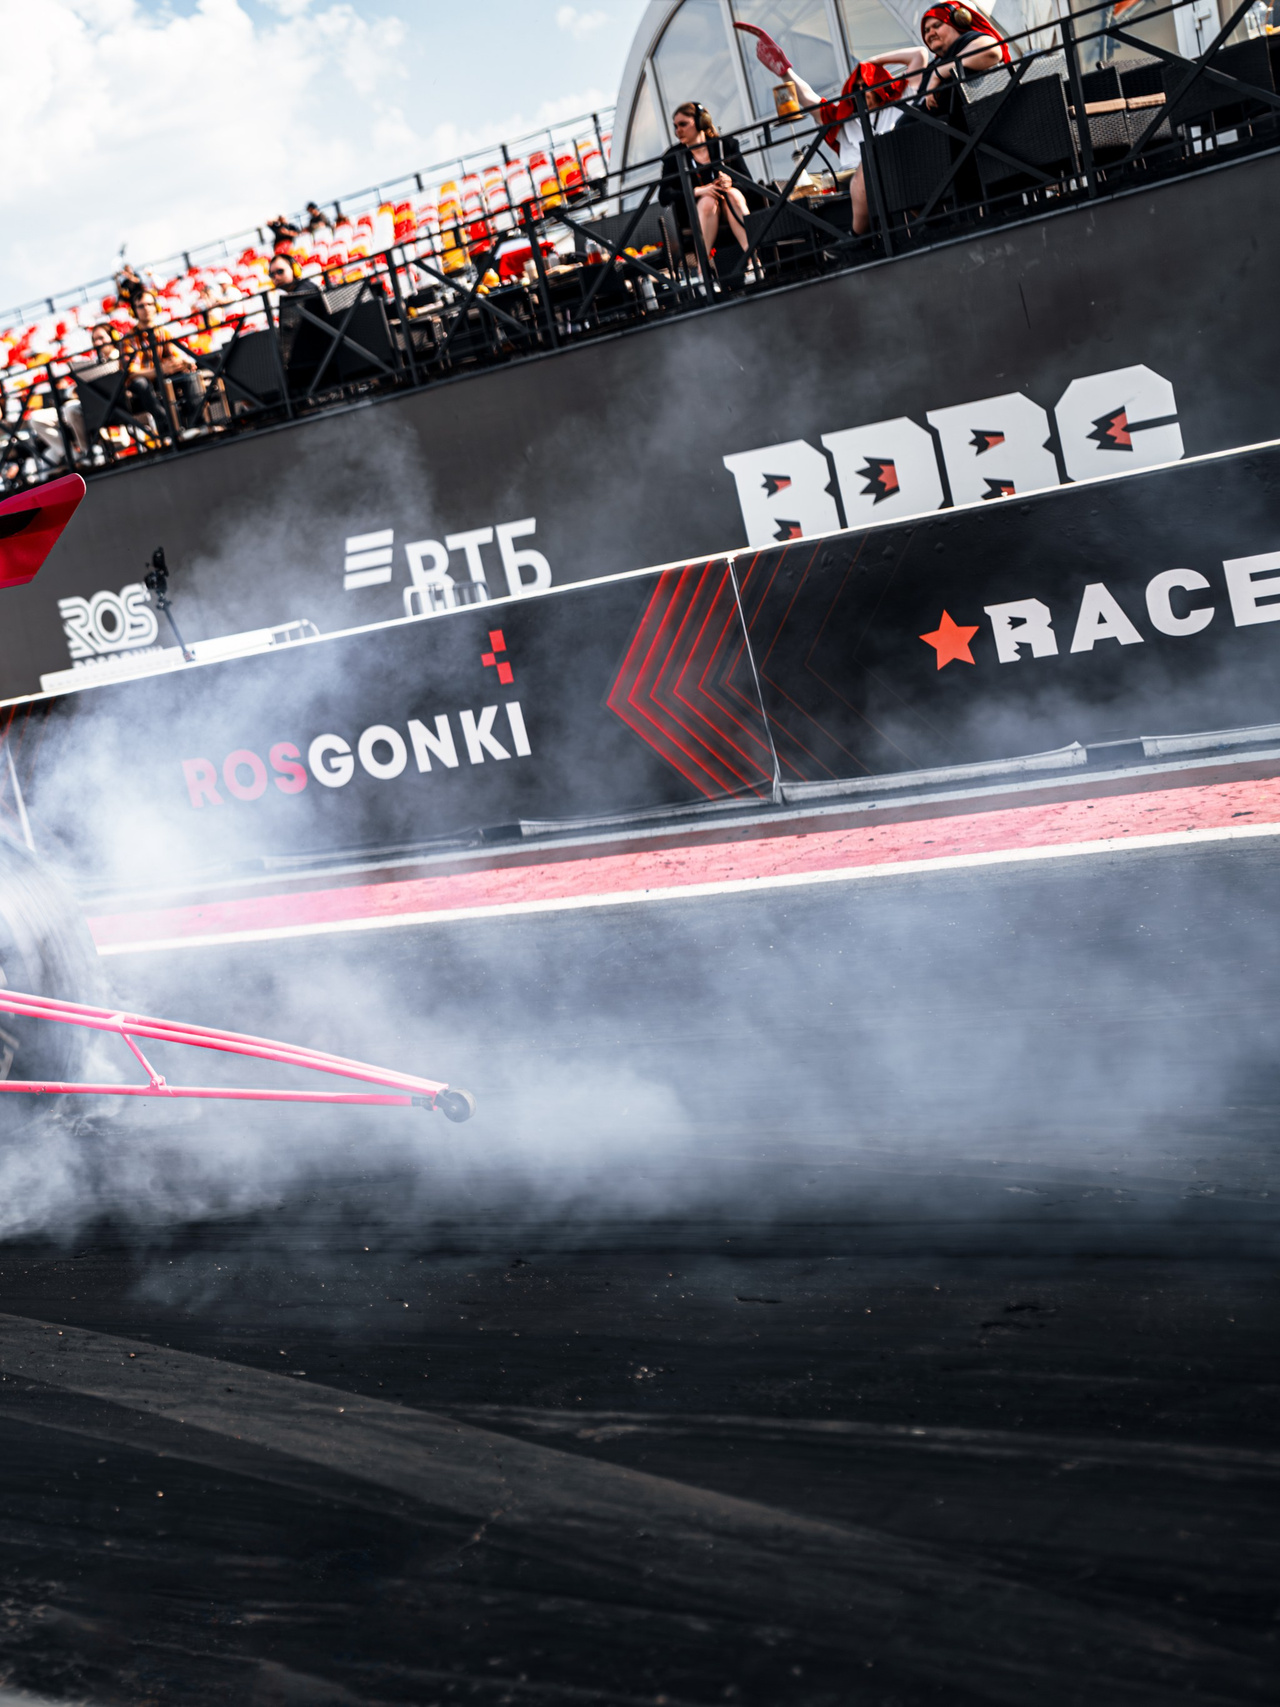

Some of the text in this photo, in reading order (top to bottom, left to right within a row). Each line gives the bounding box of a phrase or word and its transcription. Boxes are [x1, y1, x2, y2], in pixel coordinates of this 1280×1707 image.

[723, 364, 1186, 550] RDRC
[57, 582, 159, 660] ROS
[983, 550, 1280, 663] RACE
[181, 701, 532, 808] ROSGONKI
